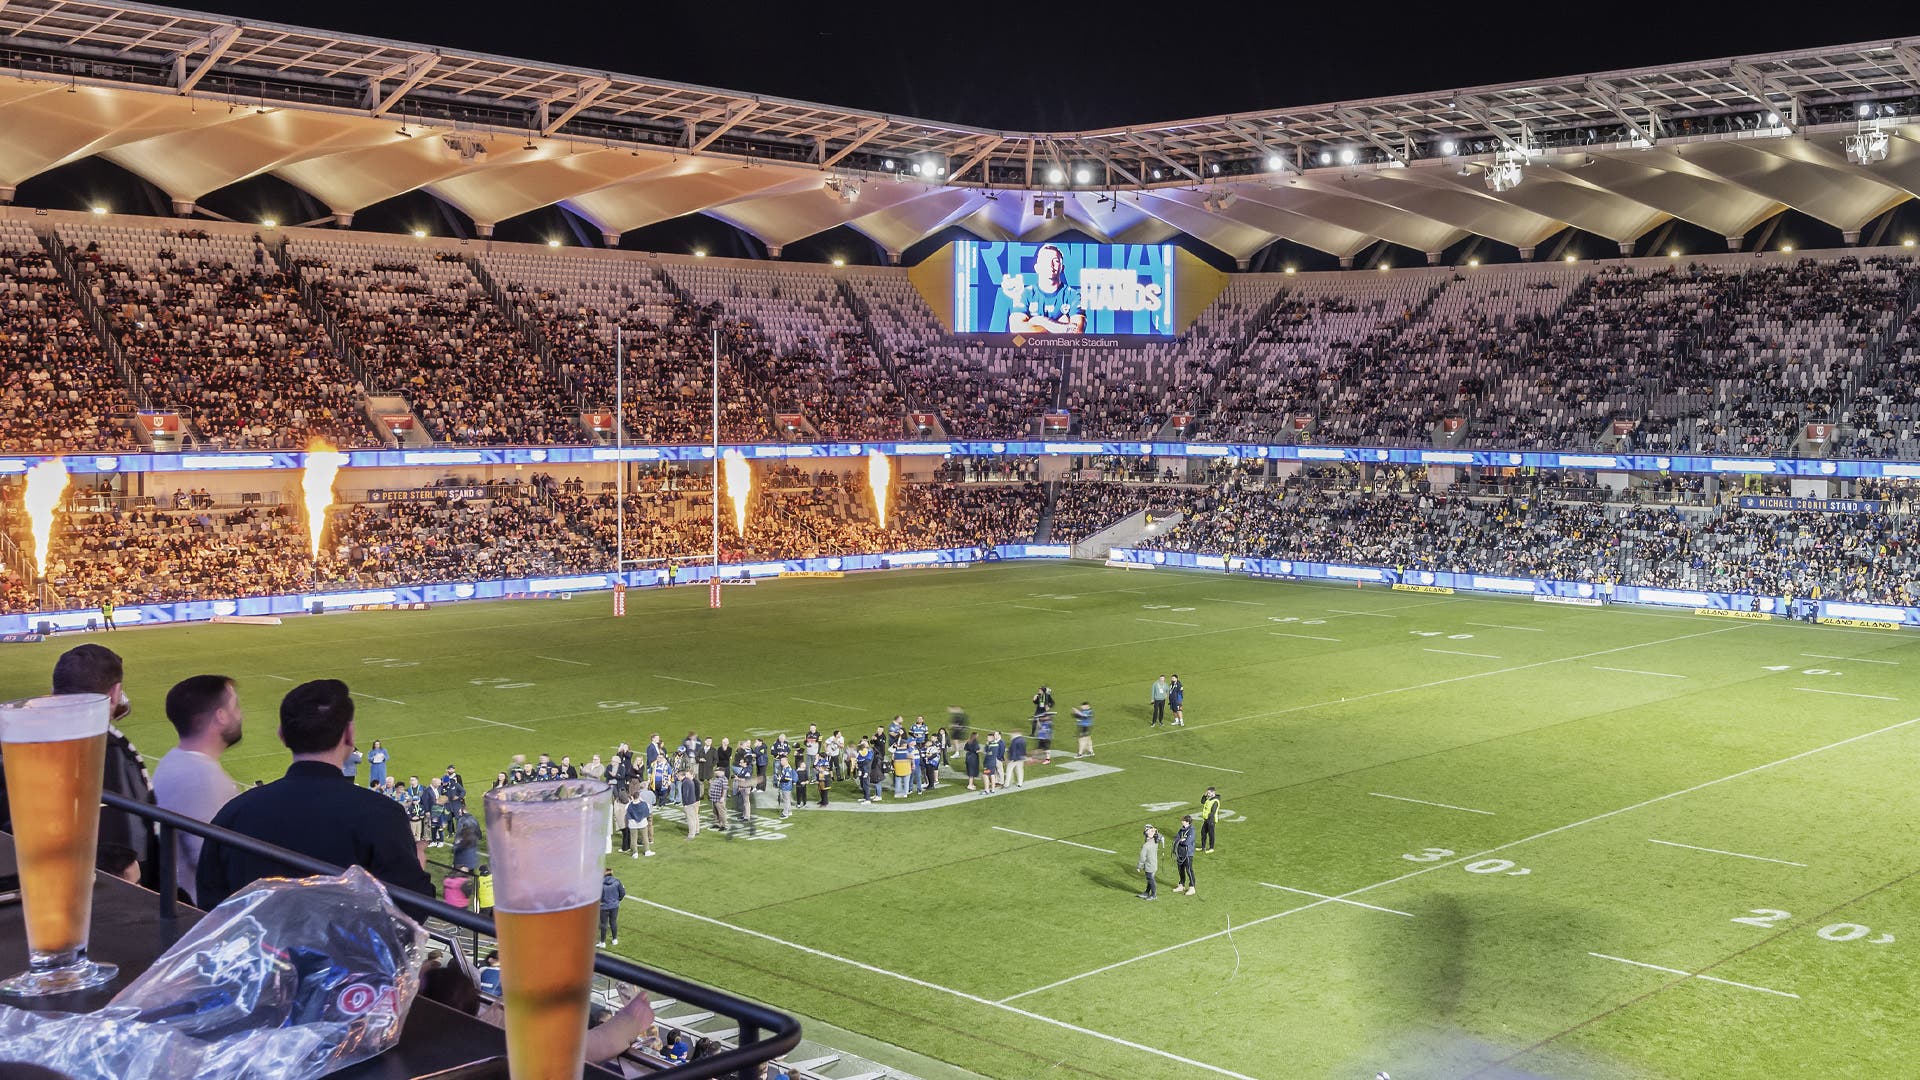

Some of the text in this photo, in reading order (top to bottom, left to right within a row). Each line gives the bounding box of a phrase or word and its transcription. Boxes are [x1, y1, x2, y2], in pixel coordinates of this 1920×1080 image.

[1028, 337, 1119, 347] CommBank Stadium
[382, 491, 408, 500] PETER
[410, 490, 448, 499] STERLING
[1760, 499, 1858, 511] MICHAEL CRONIN STAND
